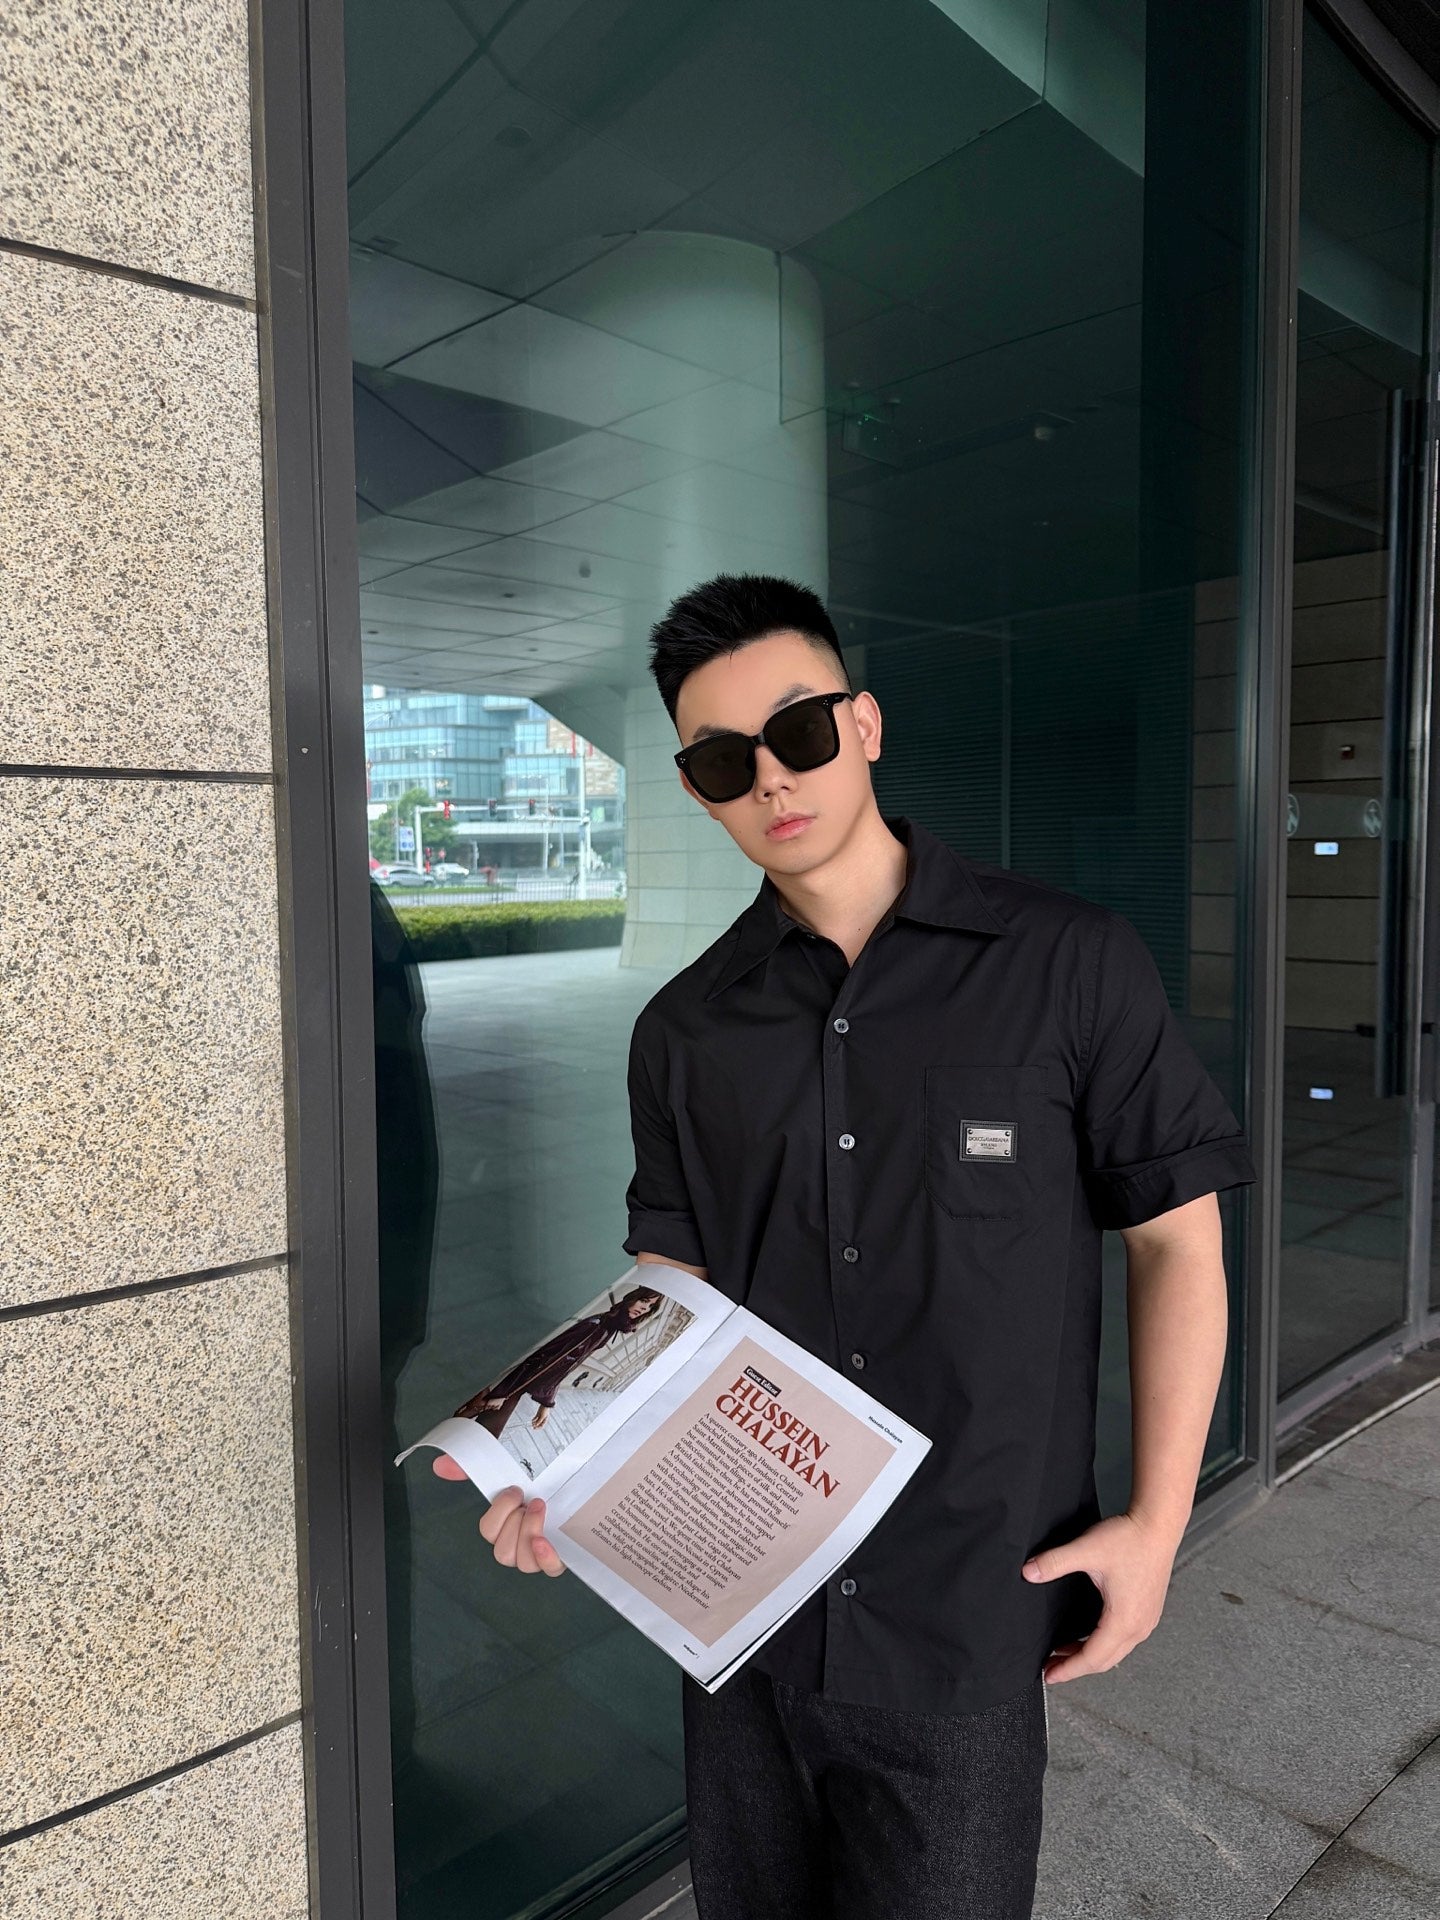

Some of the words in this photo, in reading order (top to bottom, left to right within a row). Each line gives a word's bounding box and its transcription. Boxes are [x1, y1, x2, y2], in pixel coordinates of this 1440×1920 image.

[728, 1375, 830, 1460] HUSSEIN
[746, 1368, 761, 1382] Guest
[760, 1379, 777, 1394] Editor
[715, 1394, 840, 1498] CHALAYAN
